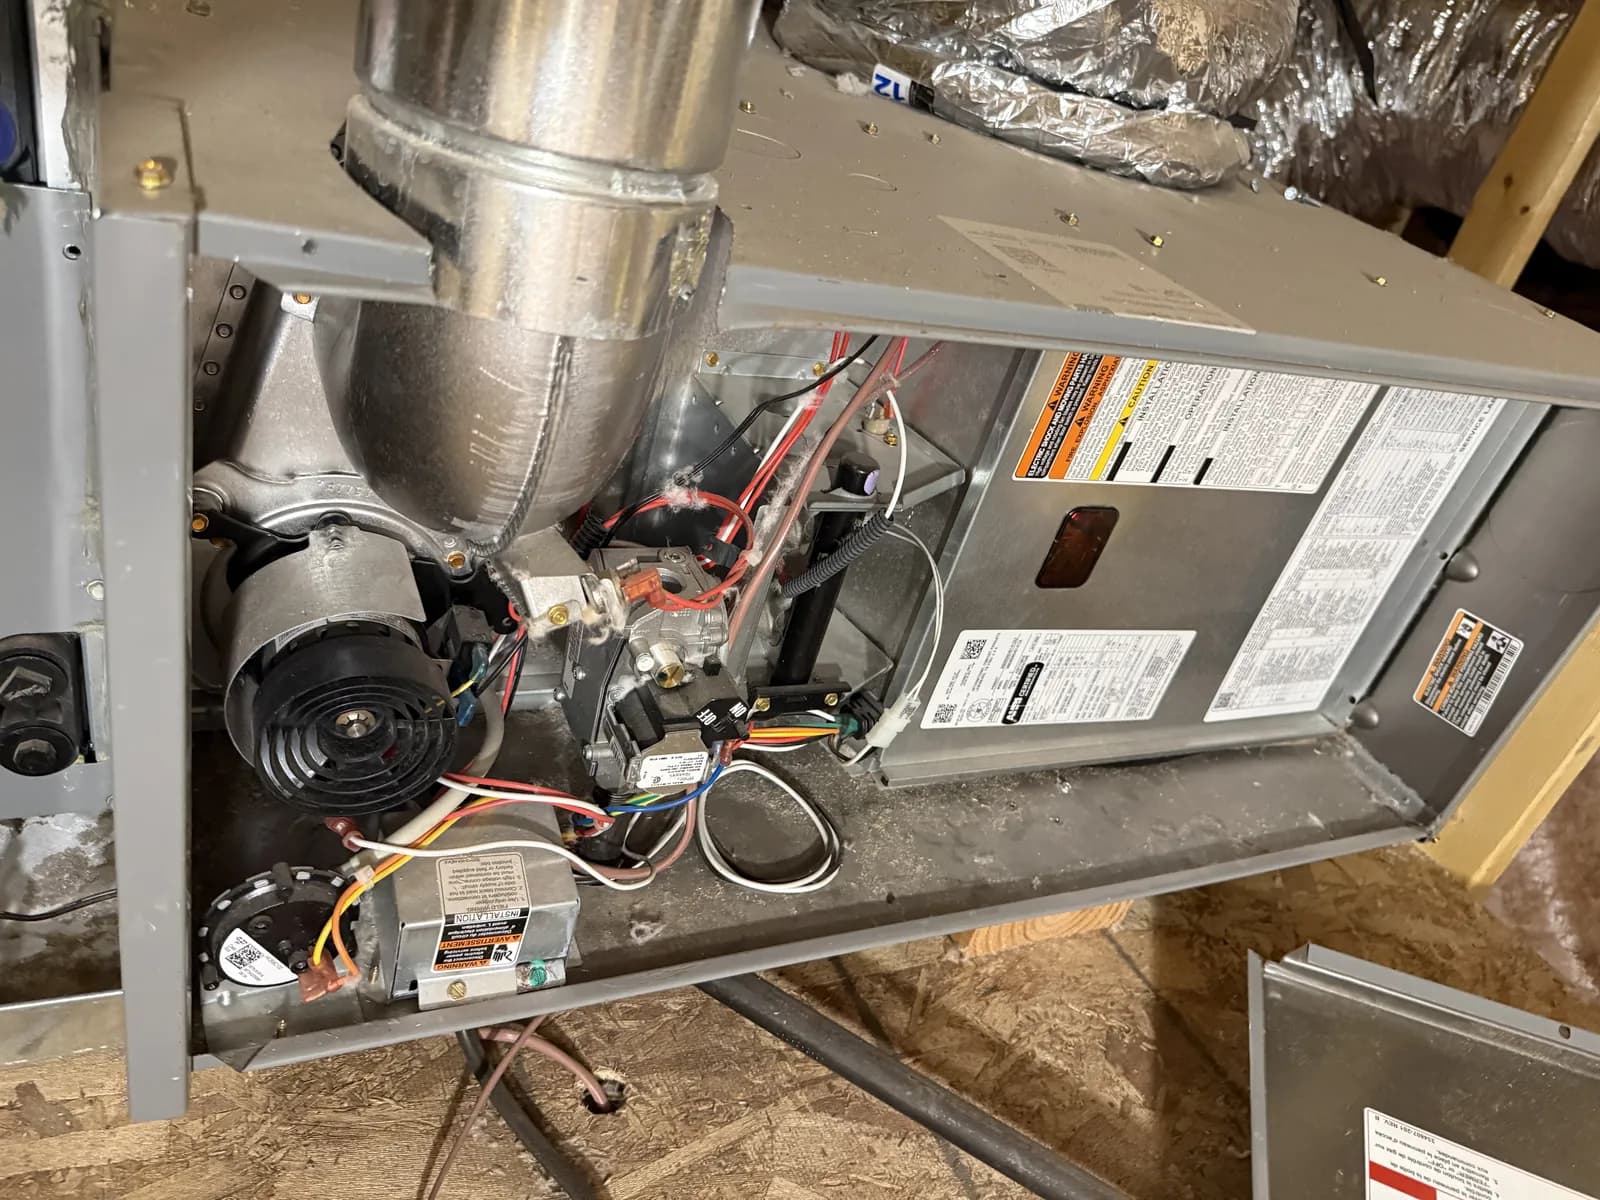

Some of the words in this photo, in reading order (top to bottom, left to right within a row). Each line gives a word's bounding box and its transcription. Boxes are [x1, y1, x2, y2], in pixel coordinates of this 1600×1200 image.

[1081, 365, 1109, 411] WARNING
[1127, 365, 1153, 407] CAUTION
[1183, 367, 1217, 419] OPERATION
[1222, 370, 1260, 431] INSTALLATION
[1026, 447, 1045, 475] ELECTRIC
[1040, 425, 1056, 446] SHOCK
[1051, 411, 1062, 424] AND
[1057, 386, 1074, 410] MOVING
[1069, 364, 1084, 385] PARTS
[696, 708, 717, 726] OFF
[729, 701, 747, 718] ON
[454, 908, 519, 923] INSTALLATION
[441, 935, 510, 948] AVERTISSEMENT
[436, 961, 477, 970] WARNING
